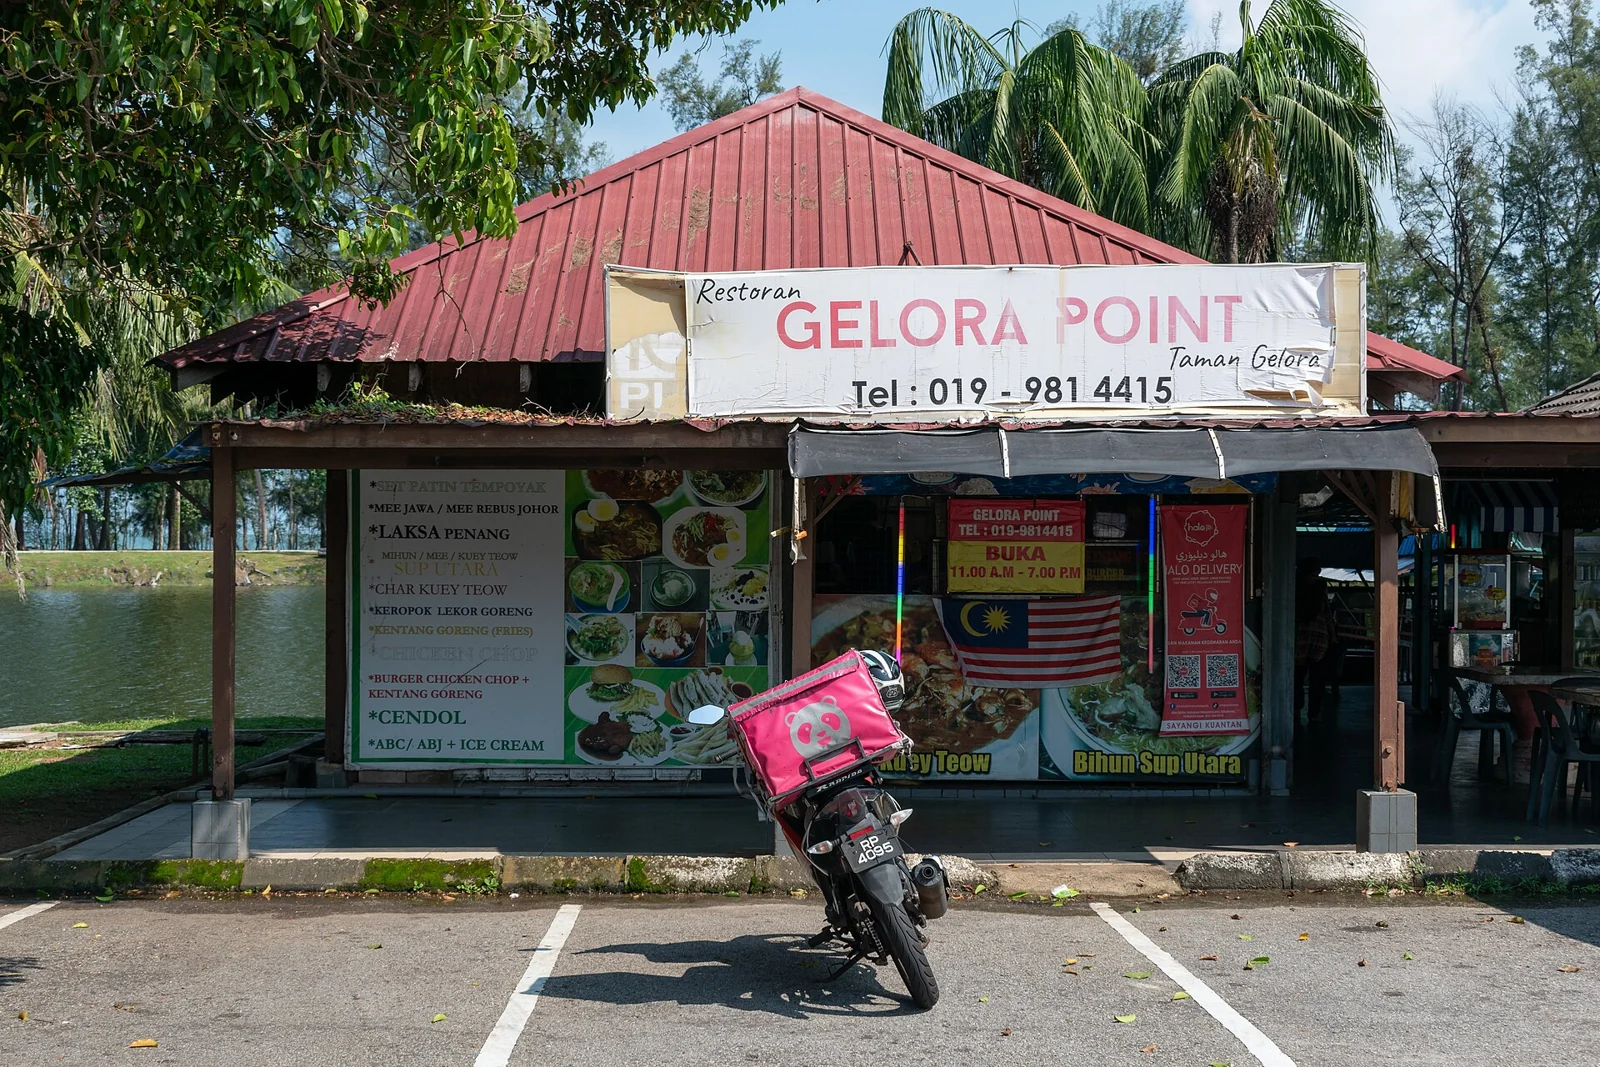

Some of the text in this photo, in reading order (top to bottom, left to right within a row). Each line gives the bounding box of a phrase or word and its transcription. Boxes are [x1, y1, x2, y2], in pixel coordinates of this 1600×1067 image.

[696, 278, 801, 305] Restoran
[776, 295, 1243, 350] GELORA POINT
[1169, 344, 1321, 371] Taman Gelora
[851, 379, 898, 408] Tel
[929, 377, 988, 405] 019
[1025, 376, 1078, 403] 981
[1093, 376, 1173, 403] 4415
[409, 481, 457, 493] PATIN
[460, 480, 548, 494] TEMPOYAK
[403, 504, 435, 516] JAWA
[446, 504, 475, 514] MEE
[476, 504, 516, 514] REBUS
[517, 504, 560, 516] JOHOR
[973, 508, 1060, 521] GELORA POINT
[444, 528, 510, 541] PENANG
[958, 524, 980, 536] TEL
[991, 524, 1074, 537] 019-9814415
[382, 551, 417, 560] MIHUN
[426, 552, 449, 561] MEE
[458, 552, 486, 561] KUEY
[487, 552, 519, 561] TEOW
[985, 545, 1047, 561] BUKA
[394, 561, 500, 577] SUP UTARA
[950, 566, 987, 578] 11.00
[989, 566, 1014, 578] A.M
[1027, 566, 1056, 578] 7.00
[1059, 566, 1081, 579] P.M
[1166, 564, 1243, 575] ALO DELIVERY
[418, 584, 461, 595] KUEY
[463, 584, 508, 596] TEOW
[437, 606, 478, 616] LEKOR
[481, 606, 534, 617] GORENG
[436, 626, 489, 636] GORENG
[491, 626, 534, 639] (FRIES)
[479, 646, 539, 662] CHOP
[426, 674, 483, 684] CHICKEN
[485, 675, 520, 684] CHOP
[368, 689, 483, 699] KENTANG GORENG
[1166, 721, 1242, 730] SAYANGI KUANTAN
[417, 739, 443, 753] ABJ
[460, 739, 487, 750] ICE
[489, 739, 545, 751] CREAM
[935, 750, 991, 773] Teow
[1073, 751, 1242, 777] Bihun Sup Utara
[859, 835, 879, 852] RP
[857, 841, 894, 865] 4095
